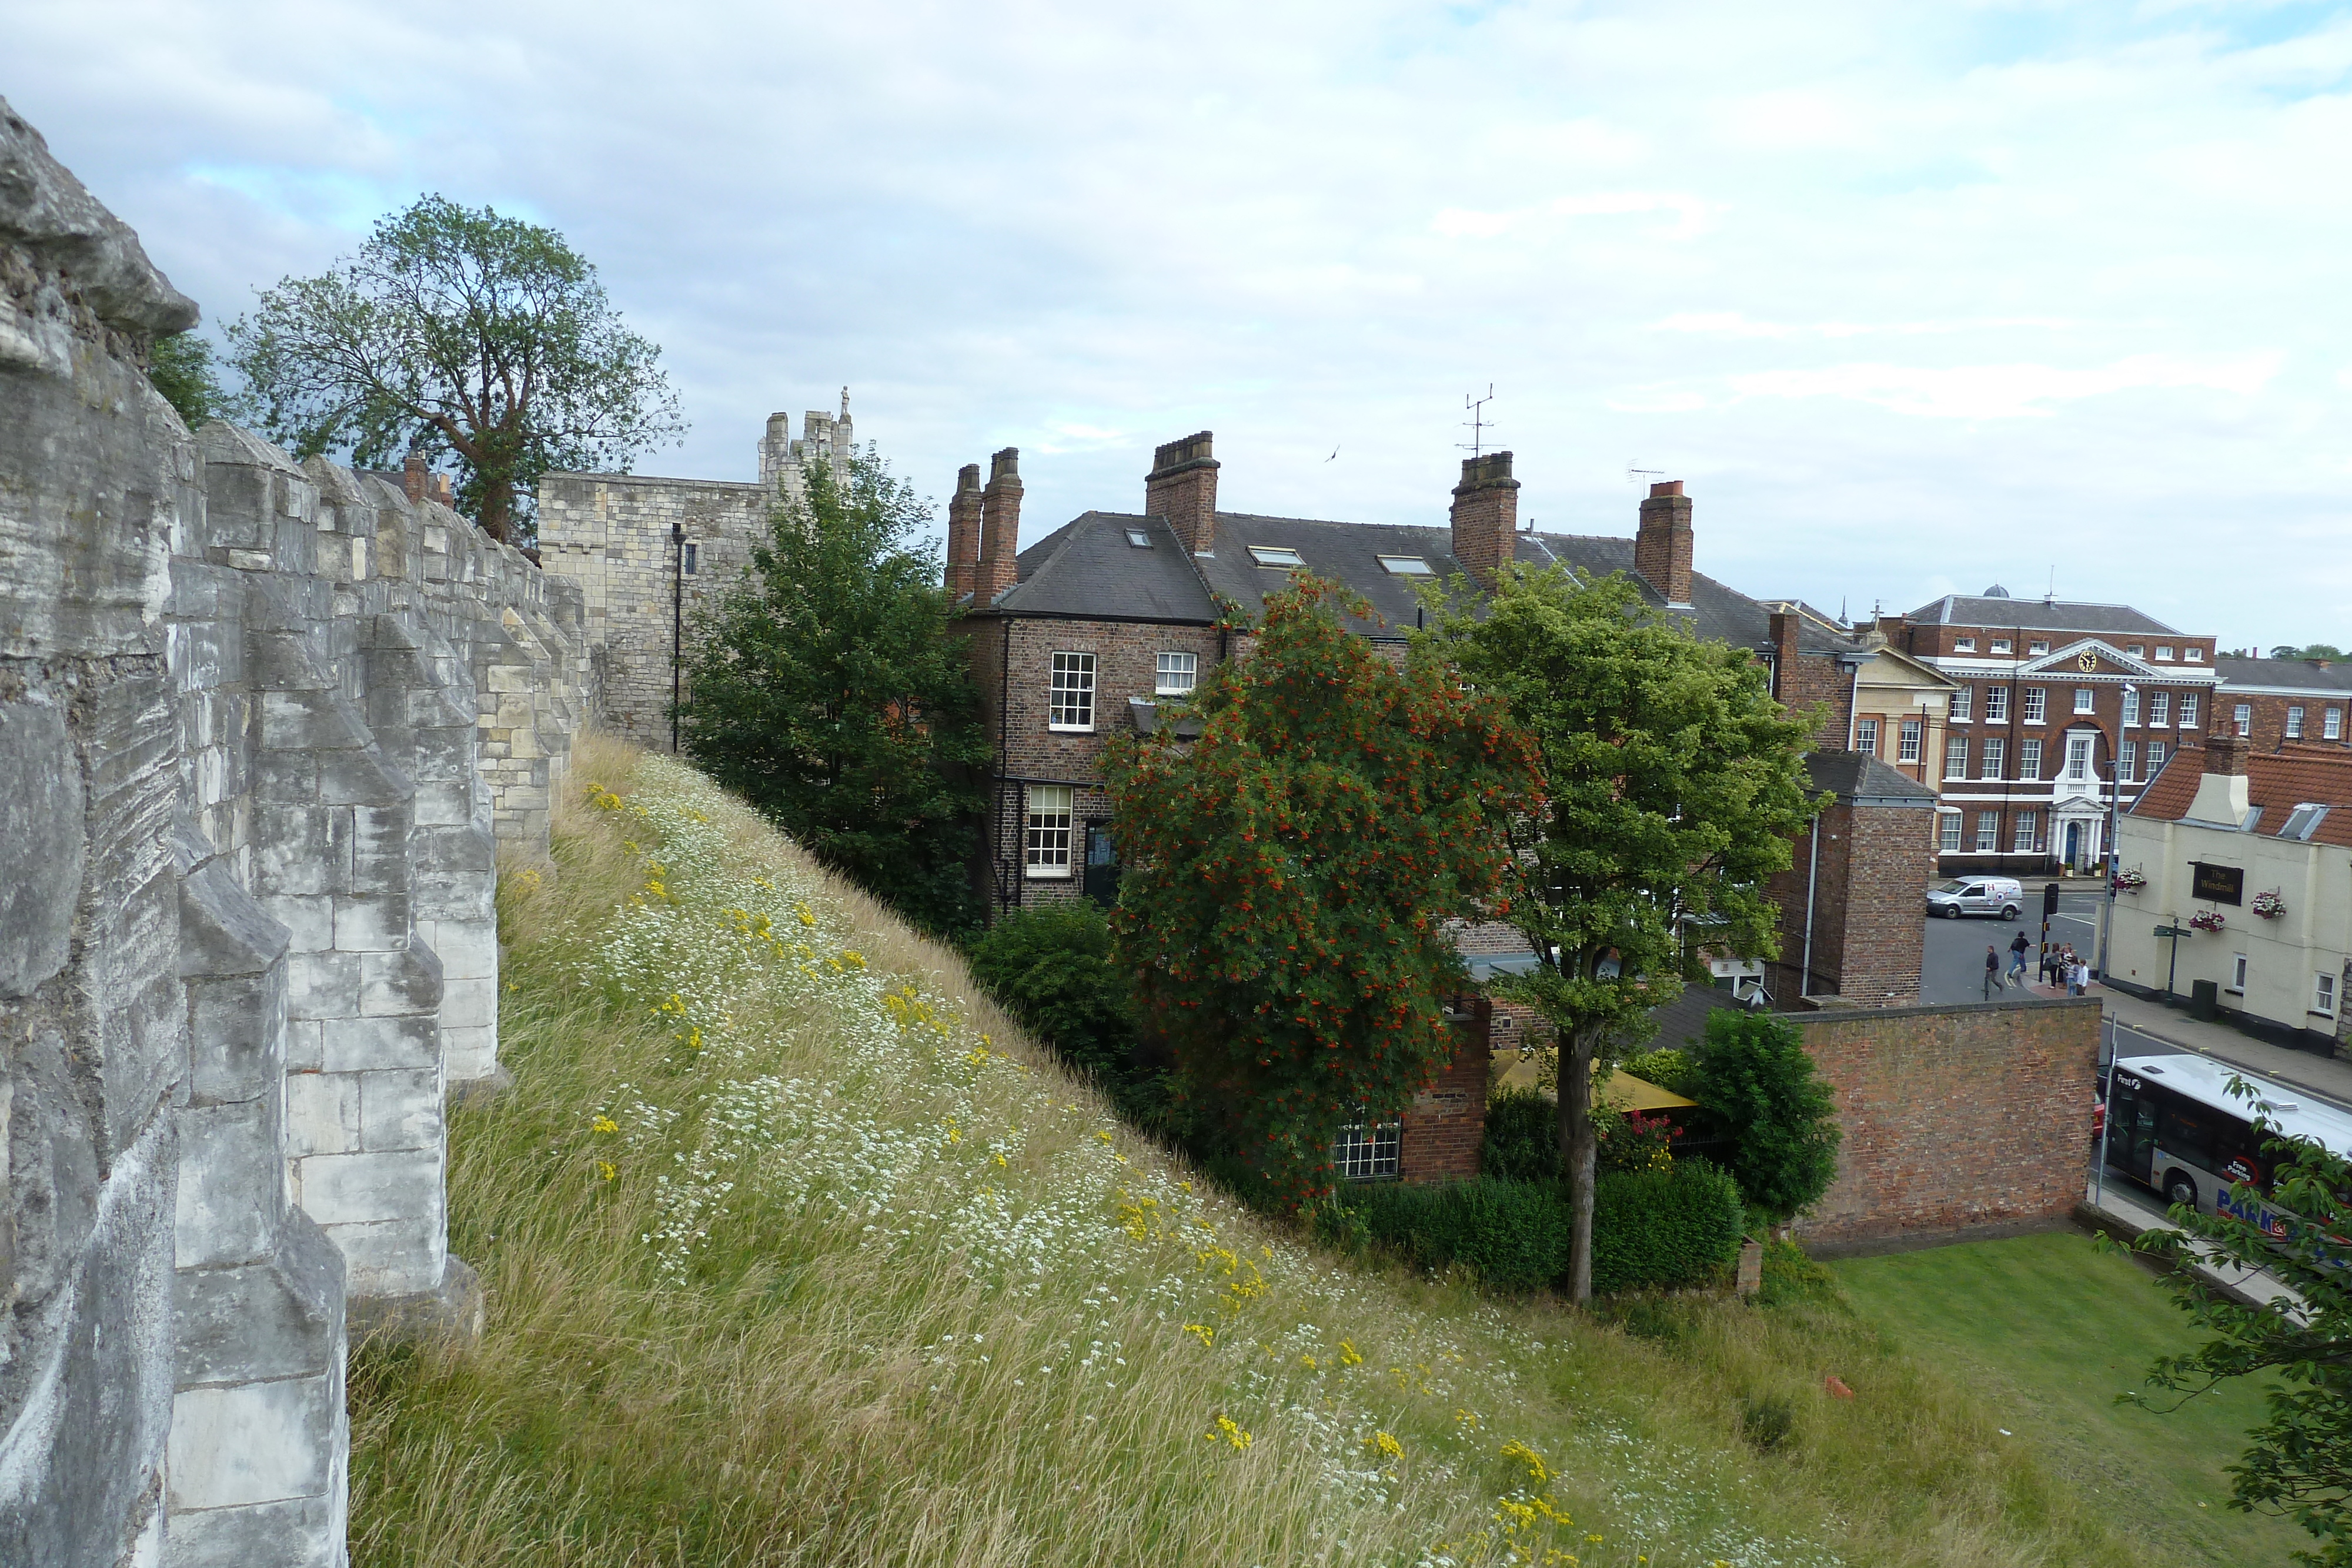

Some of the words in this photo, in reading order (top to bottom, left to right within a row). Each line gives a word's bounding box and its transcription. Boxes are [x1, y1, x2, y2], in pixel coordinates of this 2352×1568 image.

[2211, 870, 2226, 880] The
[2201, 880, 2234, 892] Windmill
[2117, 1074, 2131, 1086] First
[2233, 1161, 2247, 1172] Free
[2227, 1165, 2250, 1181] Parking
